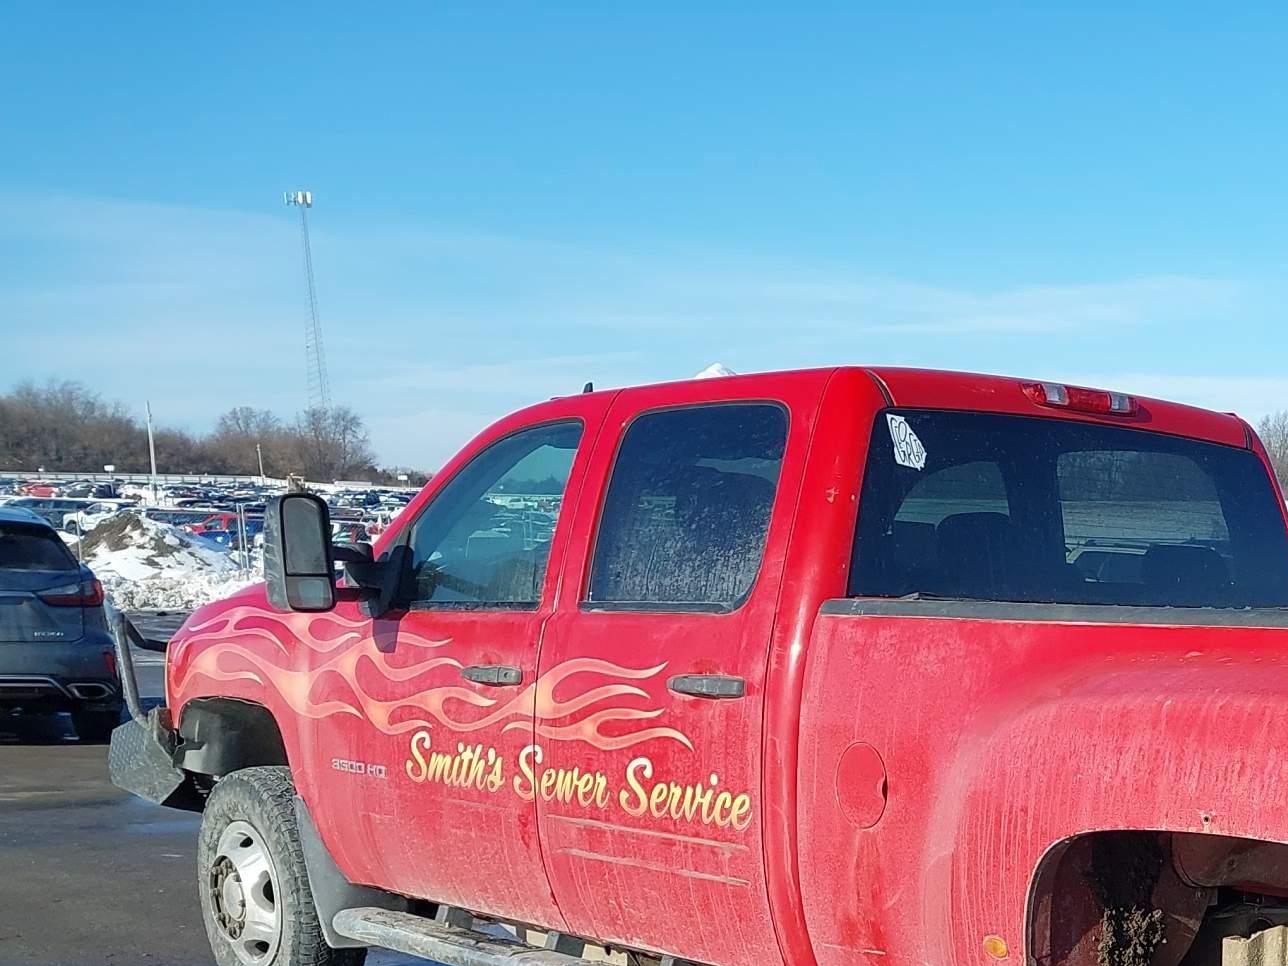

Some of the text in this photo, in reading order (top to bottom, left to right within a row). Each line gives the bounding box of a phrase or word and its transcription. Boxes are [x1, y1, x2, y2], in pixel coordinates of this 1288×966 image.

[404, 730, 753, 831] Smith's Sewer Service
